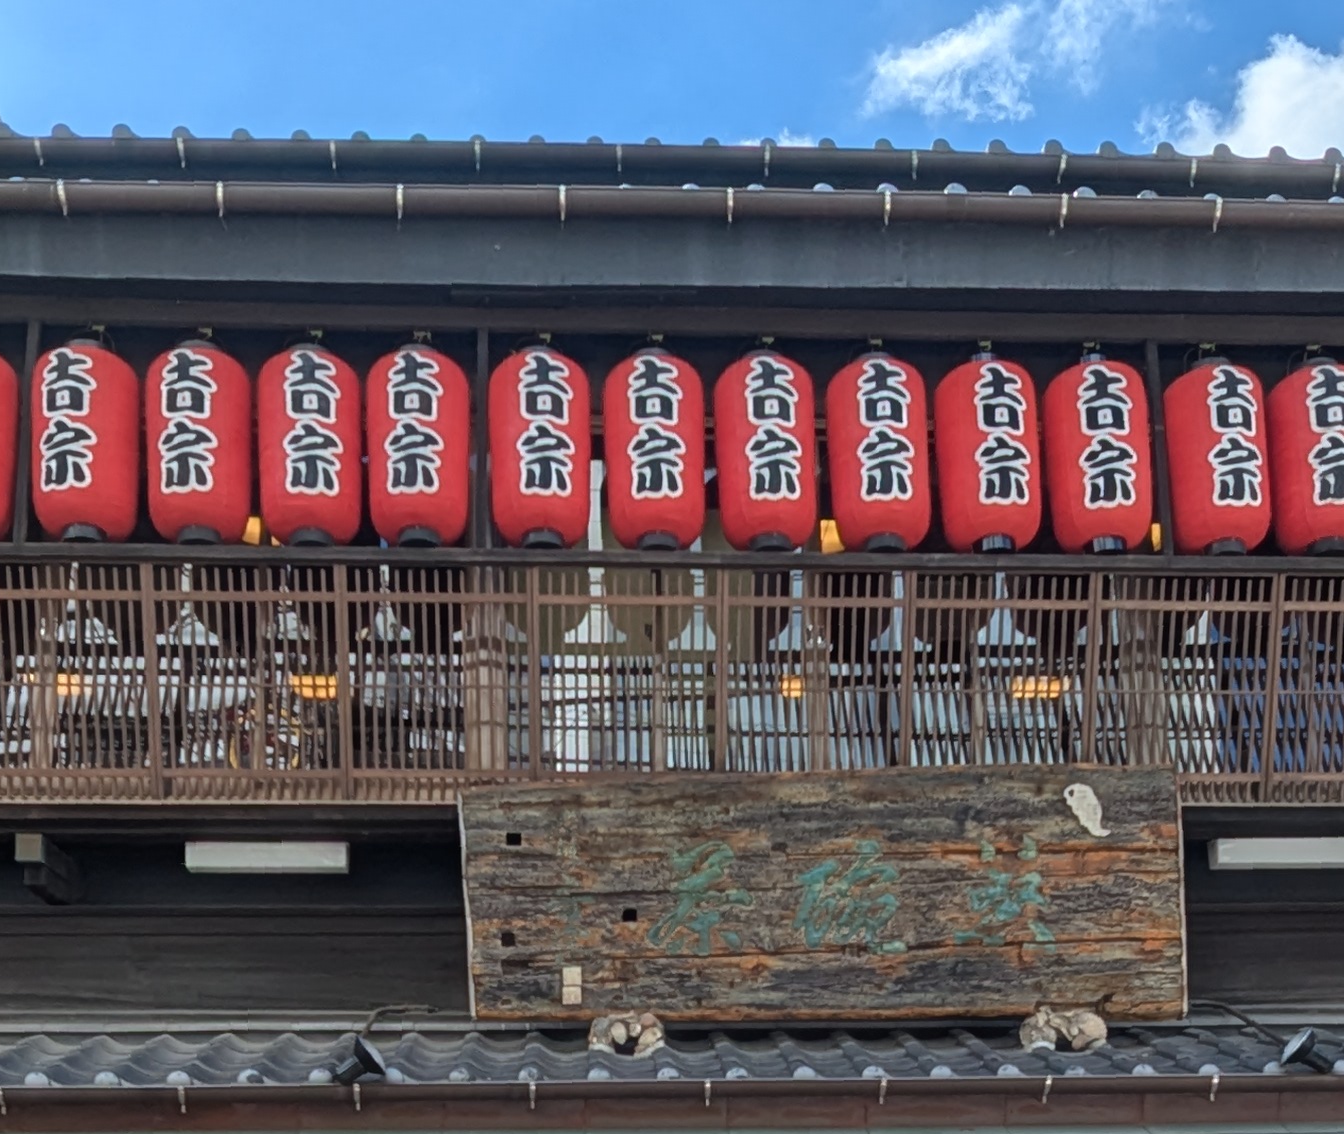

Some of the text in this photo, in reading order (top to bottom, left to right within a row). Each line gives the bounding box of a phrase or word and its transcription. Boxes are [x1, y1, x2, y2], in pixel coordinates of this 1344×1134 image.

[32, 347, 97, 492] 吉宗
[157, 348, 217, 493] 吉宗
[283, 349, 343, 496] 吉宗
[384, 349, 444, 494] 吉宗
[516, 352, 575, 496] 吉宗
[627, 355, 686, 499] 吉宗
[745, 358, 802, 501] 吉宗
[856, 359, 914, 501] 吉宗
[974, 362, 1030, 505] 吉宗
[1078, 364, 1136, 509] 吉宗
[1207, 365, 1262, 507] 吉宗
